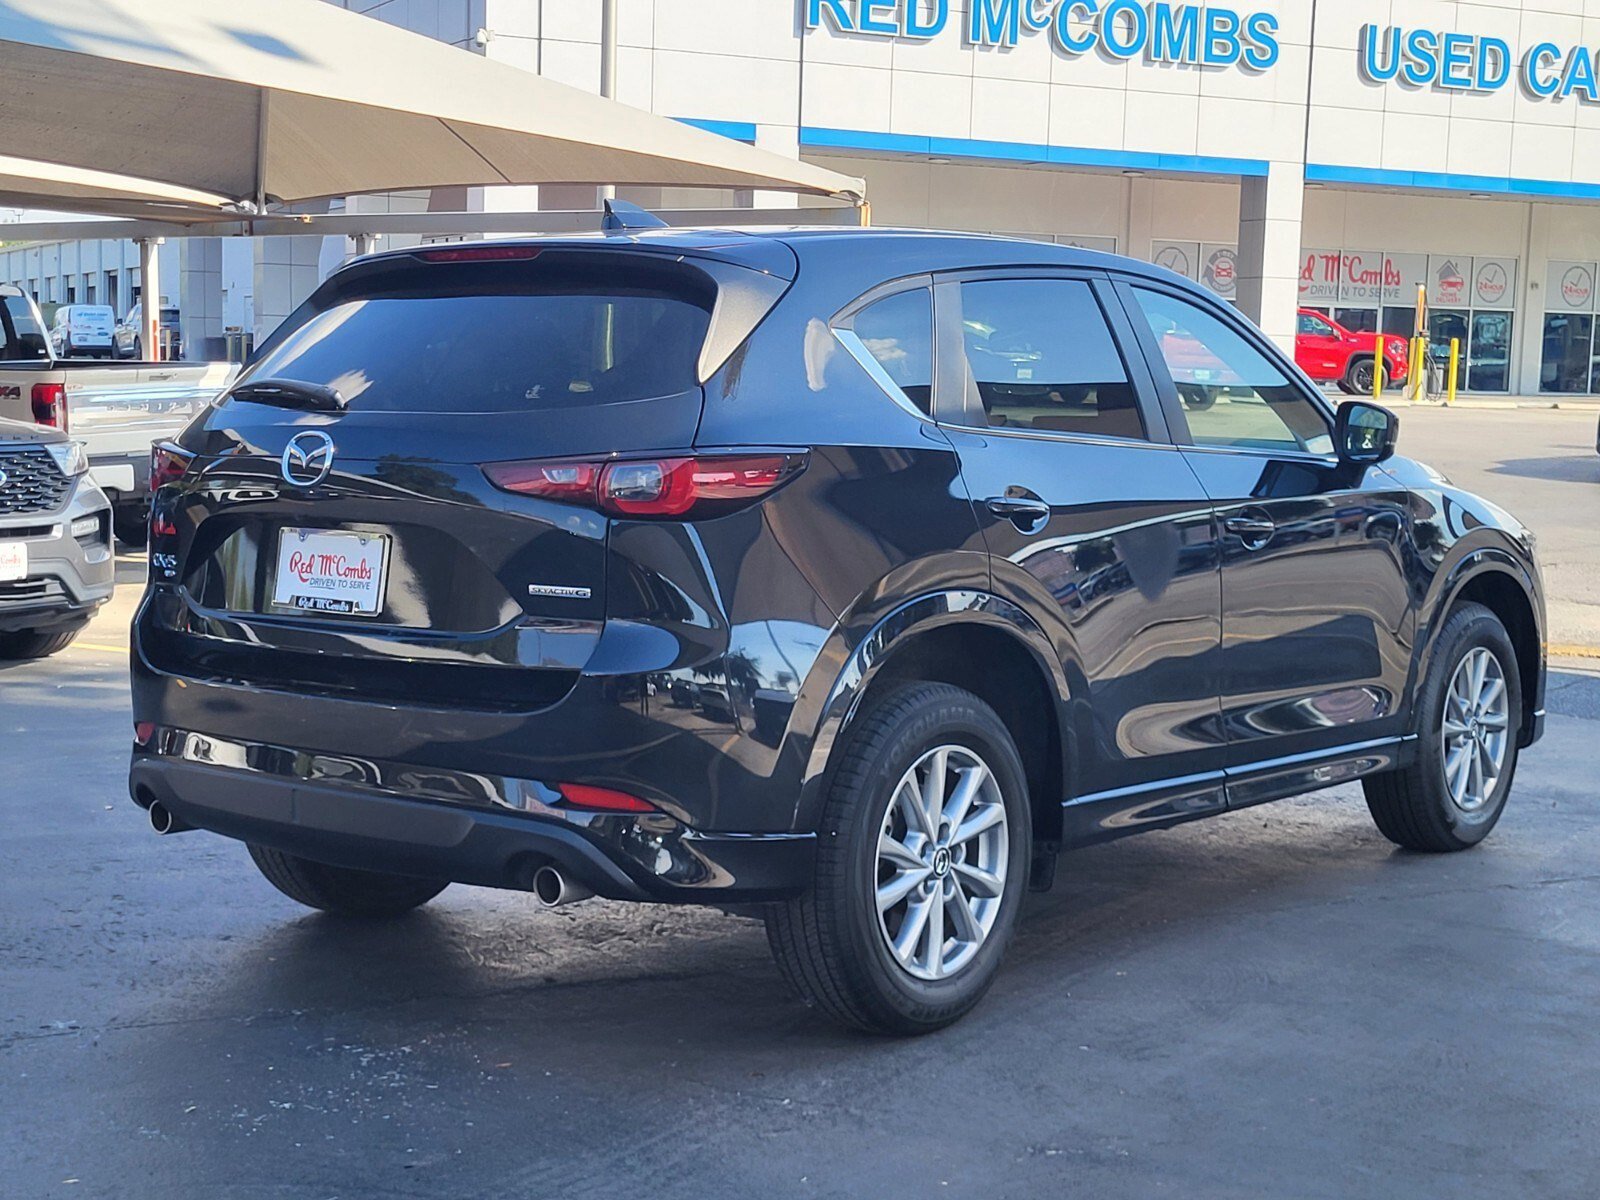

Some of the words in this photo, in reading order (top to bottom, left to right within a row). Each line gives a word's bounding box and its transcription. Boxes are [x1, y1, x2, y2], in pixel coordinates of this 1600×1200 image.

[1364, 24, 1511, 90] USED
[1352, 286, 1367, 298] TO
[289, 550, 316, 583] Red
[317, 553, 372, 580] McCombs
[309, 577, 336, 588] DRIVEN
[338, 580, 349, 589] TO
[349, 580, 371, 590] SERVE
[298, 597, 315, 610] Red
